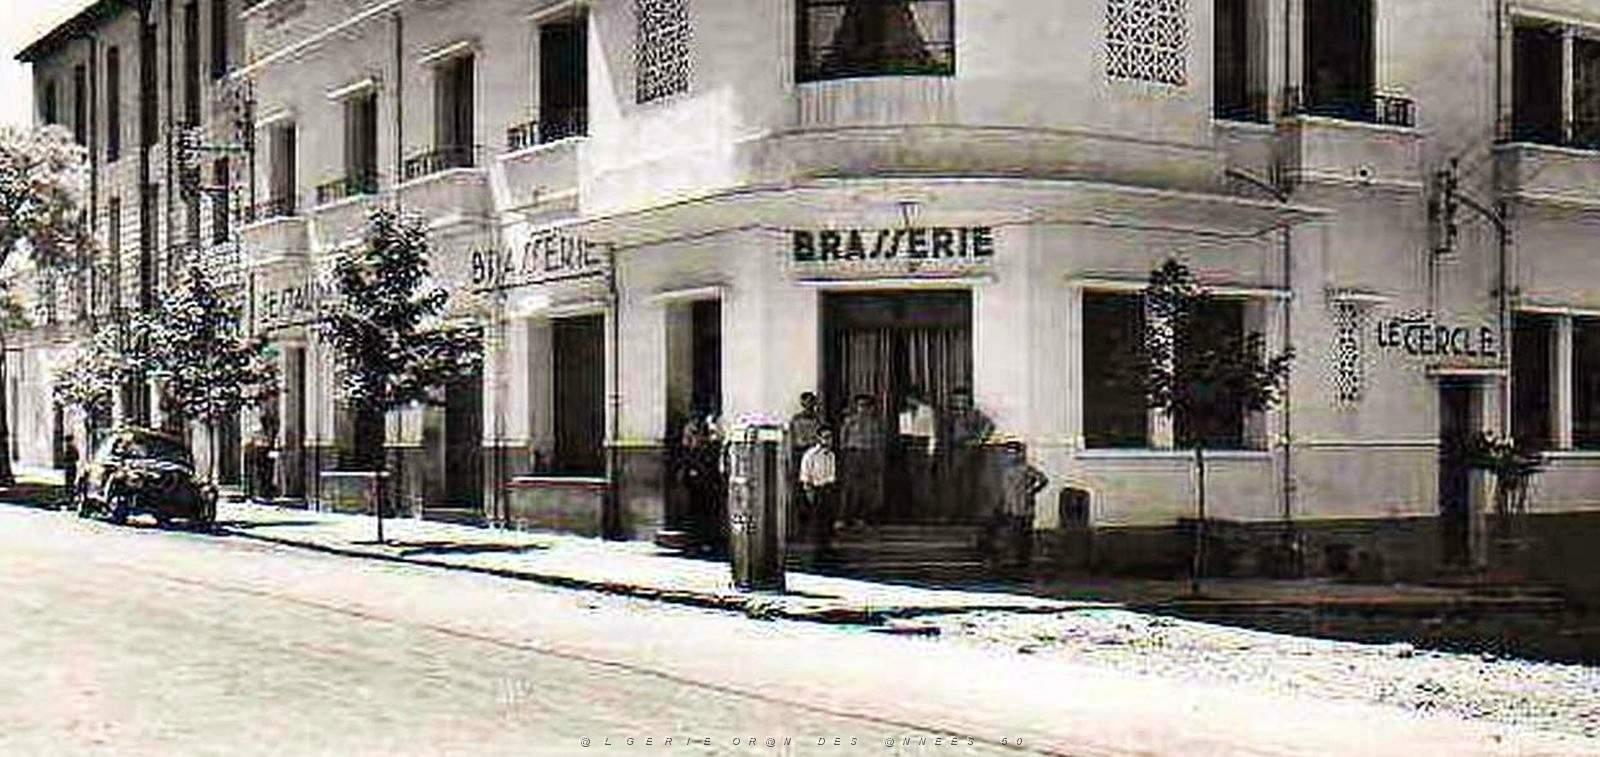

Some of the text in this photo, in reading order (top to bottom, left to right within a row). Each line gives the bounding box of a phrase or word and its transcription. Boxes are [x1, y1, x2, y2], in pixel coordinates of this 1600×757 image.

[792, 226, 994, 262] BRASSERIE
[1377, 318, 1497, 358] LE CERCLE
